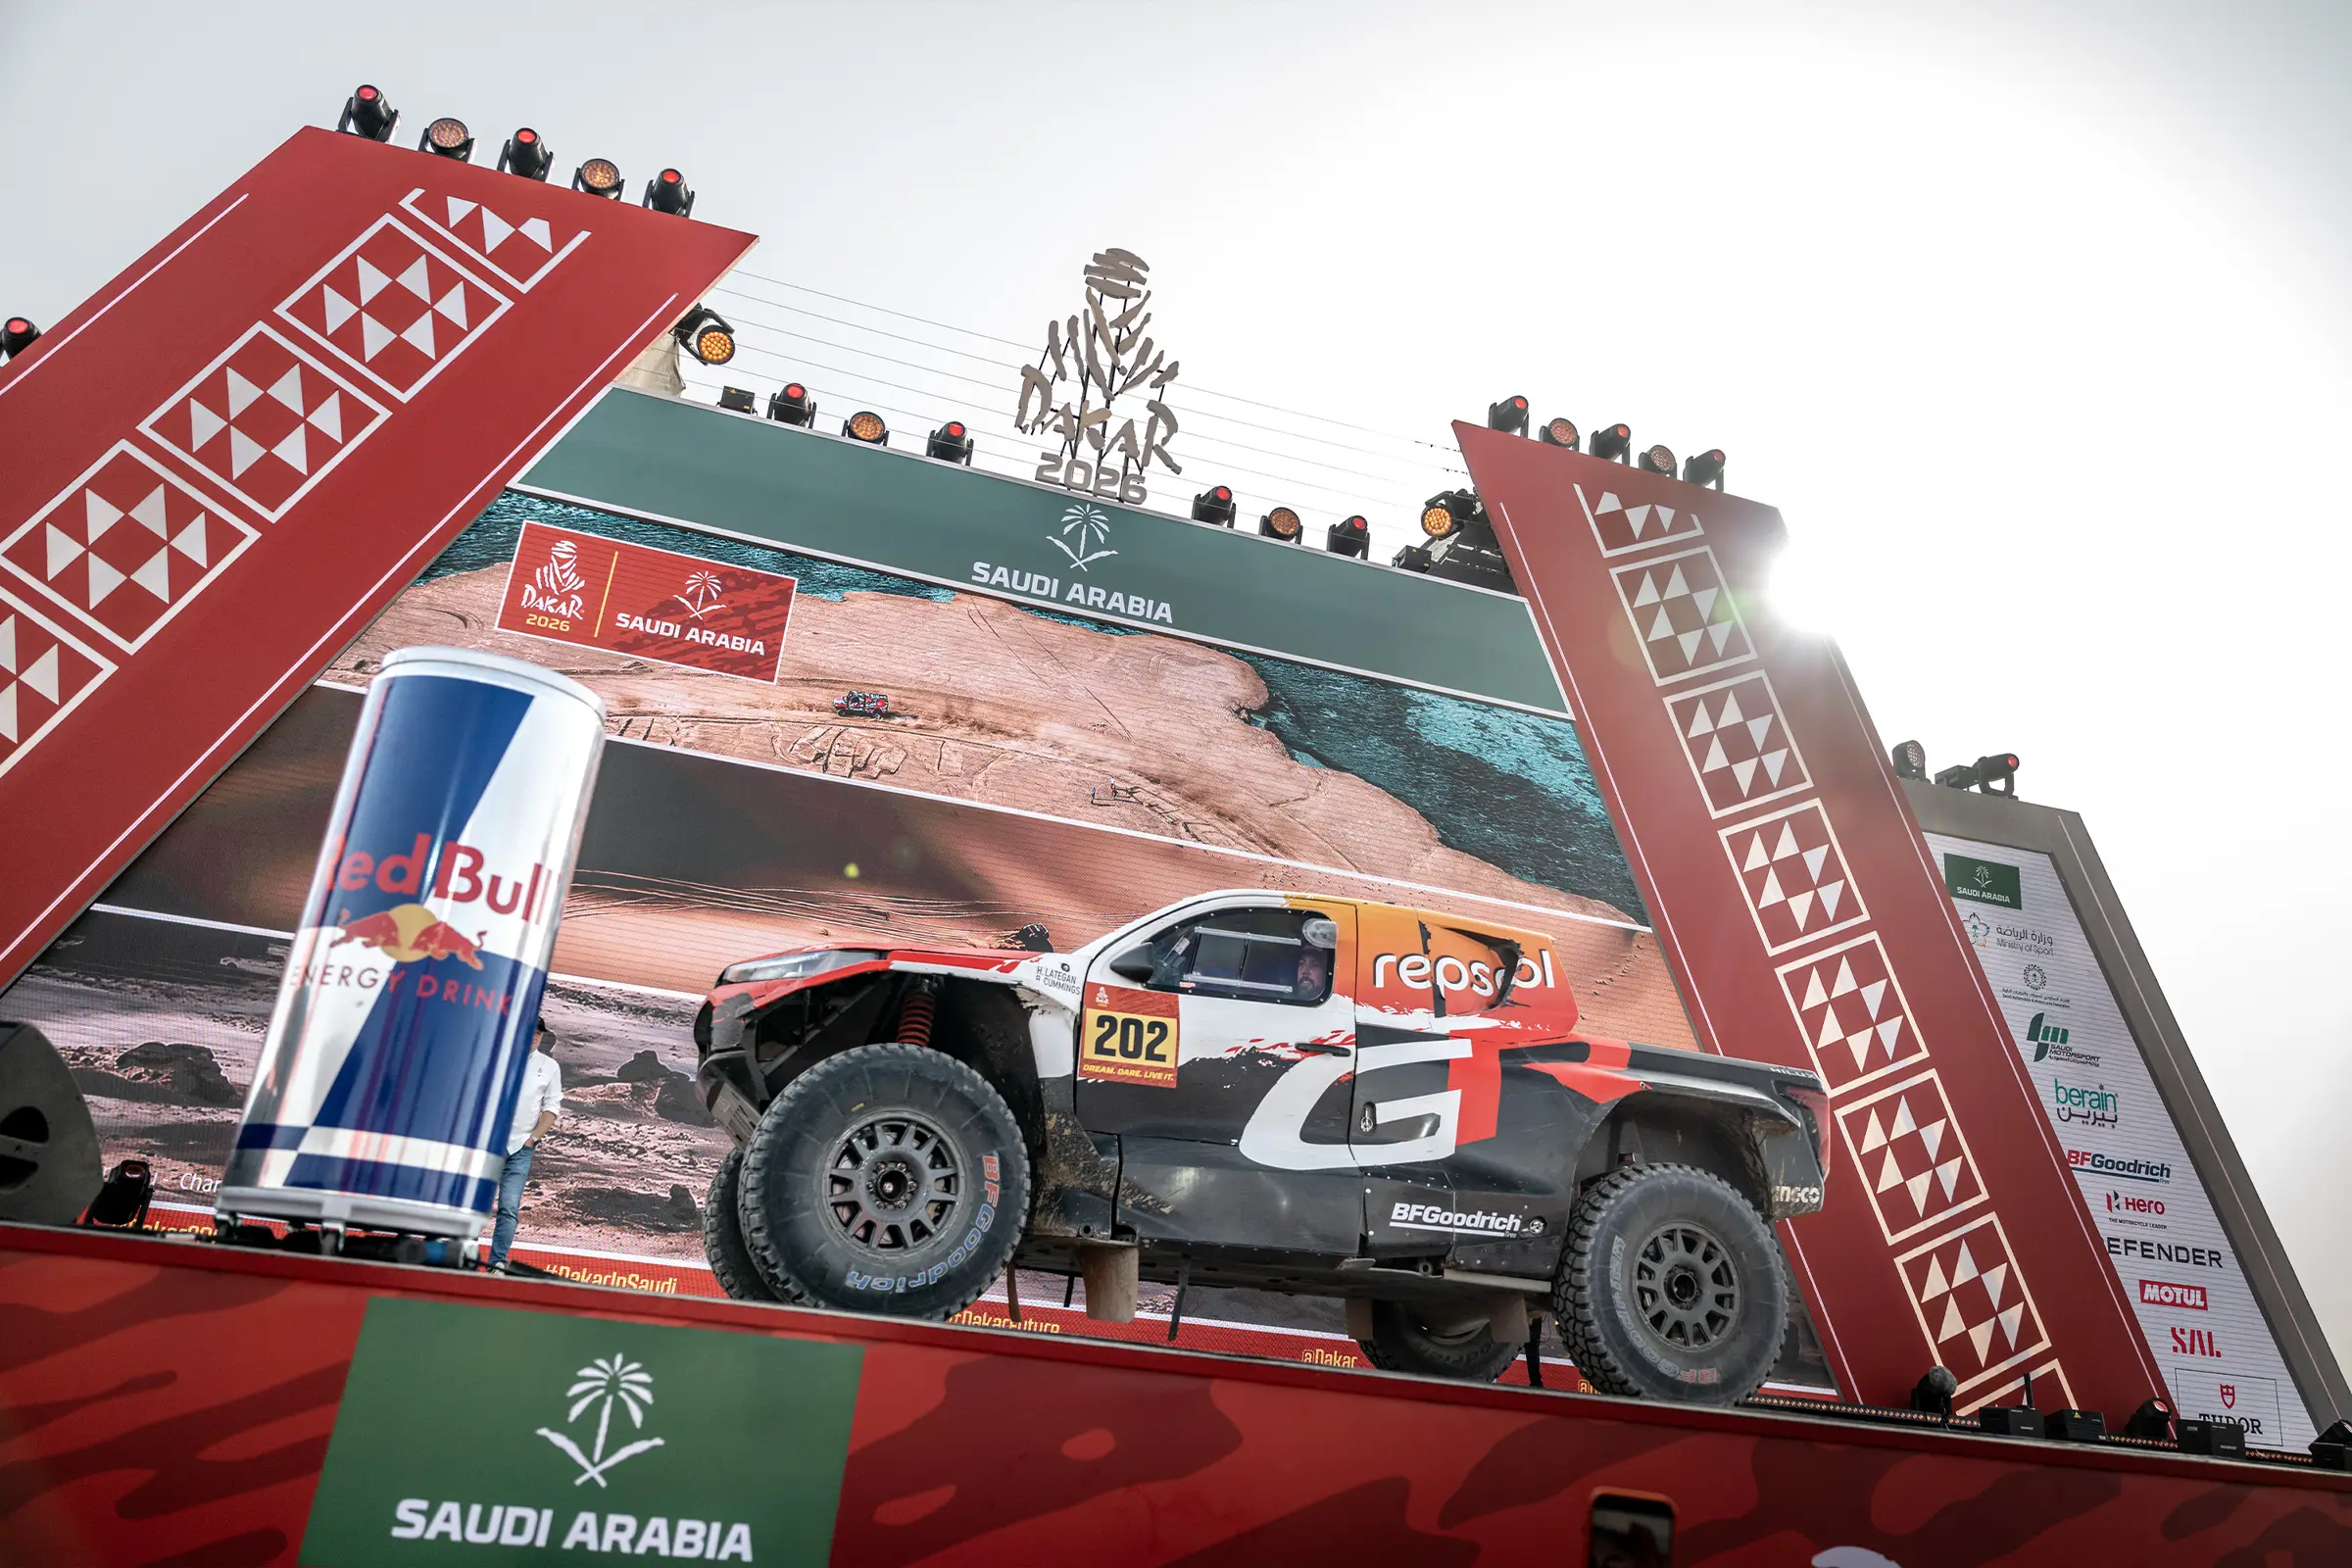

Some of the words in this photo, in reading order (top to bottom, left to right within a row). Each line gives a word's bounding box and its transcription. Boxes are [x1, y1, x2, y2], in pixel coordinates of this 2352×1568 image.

[1014, 365, 1182, 475] DAKAR
[1034, 452, 1148, 506] 2026
[520, 584, 583, 620] DAKAR
[971, 561, 1059, 599] SAUDI
[1065, 583, 1174, 624] ARABIA
[525, 613, 570, 632] 2026
[615, 612, 681, 639] SAUDI
[684, 626, 766, 656] ARABIA
[433, 840, 553, 926] Bull
[1956, 887, 1981, 898] SAUDI
[1982, 892, 2011, 903] ARABIA
[1996, 938, 2023, 952] Ministry
[2025, 944, 2033, 953] of
[2034, 946, 2054, 956] Sport
[1043, 977, 1081, 996] CUMMINGS
[1045, 968, 1077, 984] LATEGAN
[1373, 950, 1555, 1000] repsol
[416, 975, 514, 1015] DRINK
[1094, 1014, 1168, 1062] 202
[1083, 1064, 1115, 1074] DREAM.
[1144, 1071, 1163, 1080] LIVE
[2049, 1050, 2100, 1061] MOTORSPORT
[2054, 1078, 2117, 1112] berain
[2068, 1150, 2171, 1178] BFGoodrich
[848, 1155, 1000, 1293] BFGoodrich
[1391, 1201, 1521, 1232] BFGoodrich
[2105, 1237, 2223, 1268] EFENDER
[2143, 1283, 2205, 1307] MOTUL
[391, 1496, 554, 1548] SAUDI
[562, 1511, 754, 1563] ARABIA
